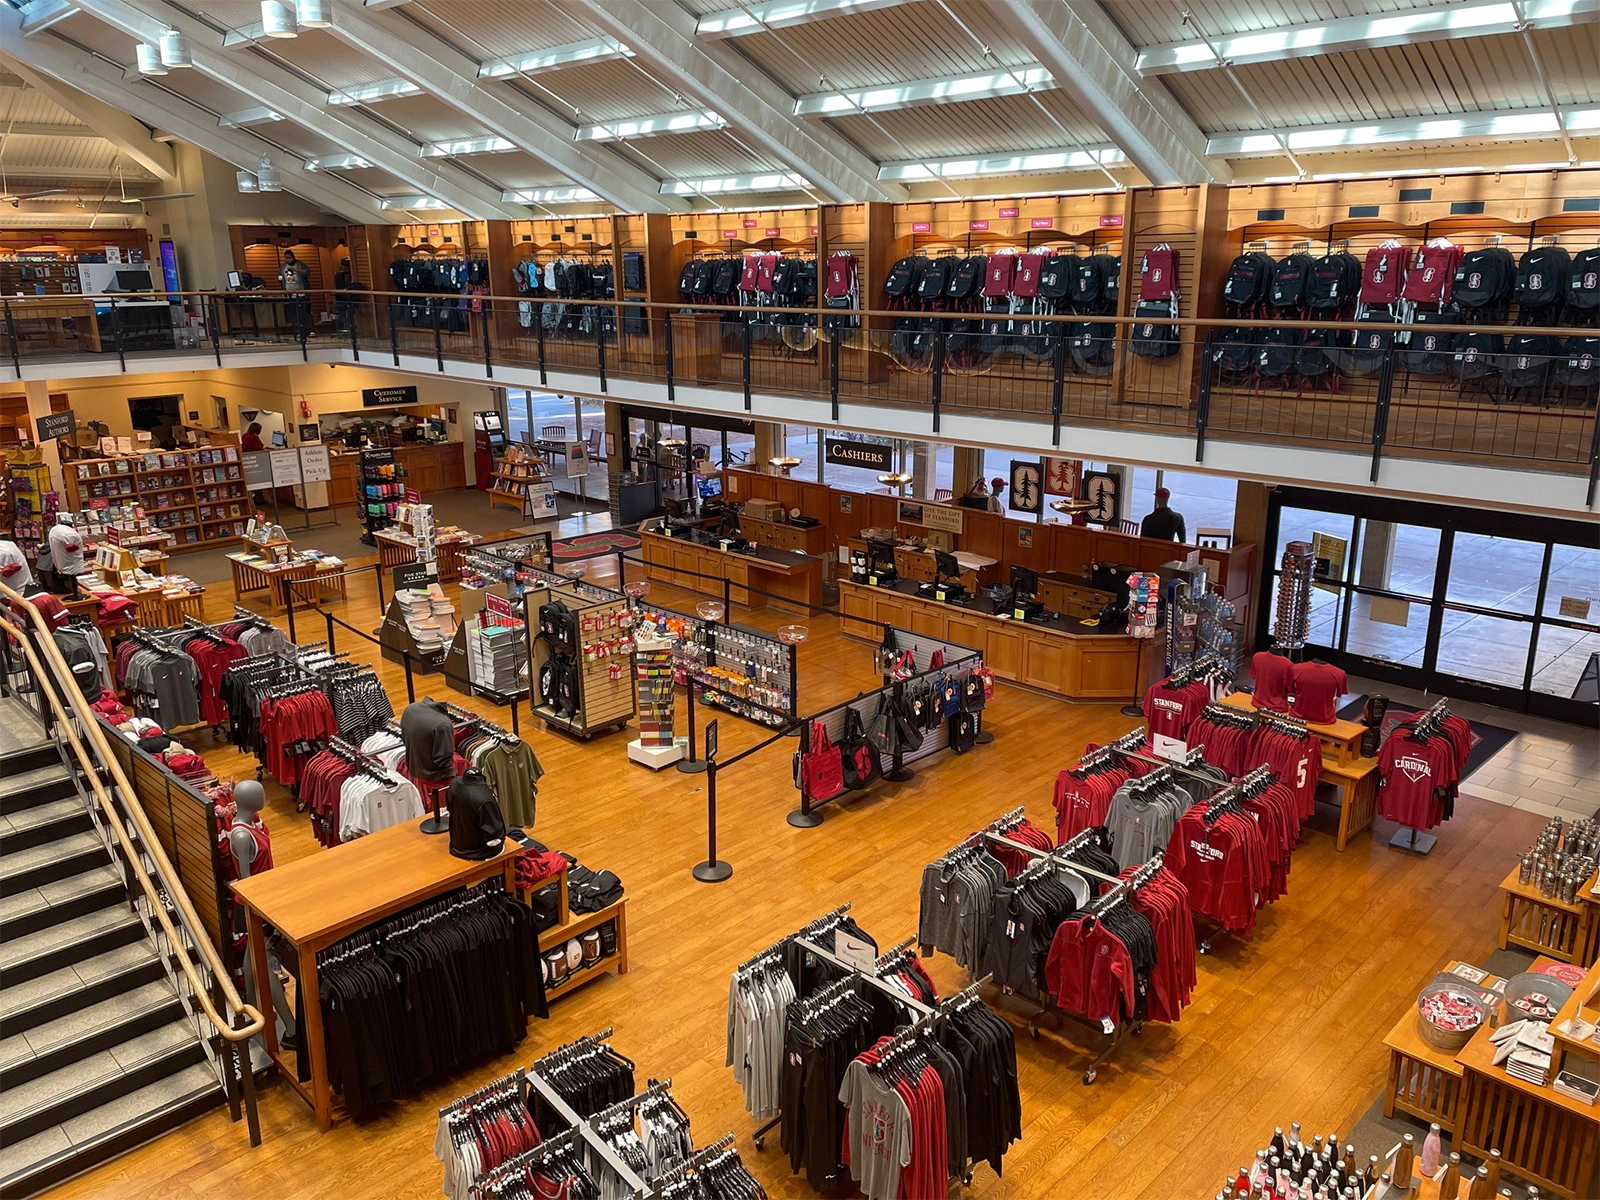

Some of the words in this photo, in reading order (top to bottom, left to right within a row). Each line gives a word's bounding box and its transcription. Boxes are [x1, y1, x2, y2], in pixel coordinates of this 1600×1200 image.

[373, 389, 406, 397] CUSTOMER
[45, 415, 69, 428] STANFORD
[48, 425, 70, 438] AUTHORS
[832, 444, 883, 463] CASHIERS
[932, 514, 960, 524] STANFORD
[1165, 602, 1174, 669] smartwater
[1154, 698, 1183, 711] STANFORD
[1296, 758, 1309, 789] 5
[1395, 759, 1432, 777] CARDINAL
